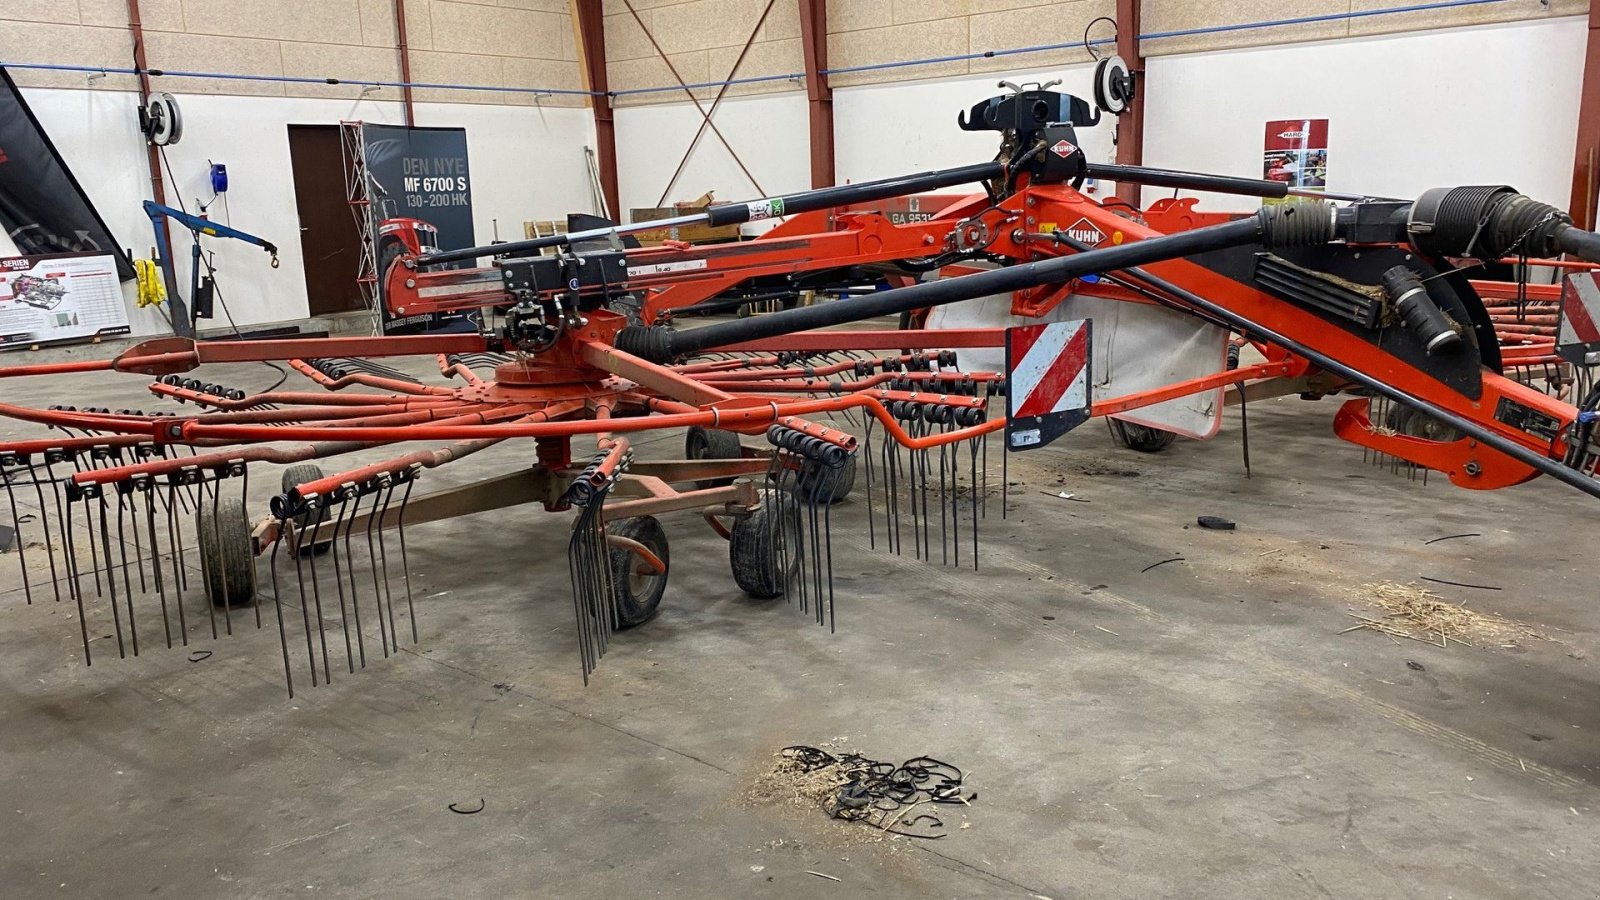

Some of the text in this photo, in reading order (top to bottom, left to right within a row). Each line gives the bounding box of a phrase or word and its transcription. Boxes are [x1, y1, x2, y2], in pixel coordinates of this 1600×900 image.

[403, 157, 465, 175] DEN NYE
[404, 176, 467, 192] MF 6700 S
[451, 193, 468, 206] HK
[892, 213, 906, 225] GA
[1068, 229, 1099, 243] KUHN
[2, 258, 29, 268] SERIEN
[406, 314, 433, 325] FERGUSON
